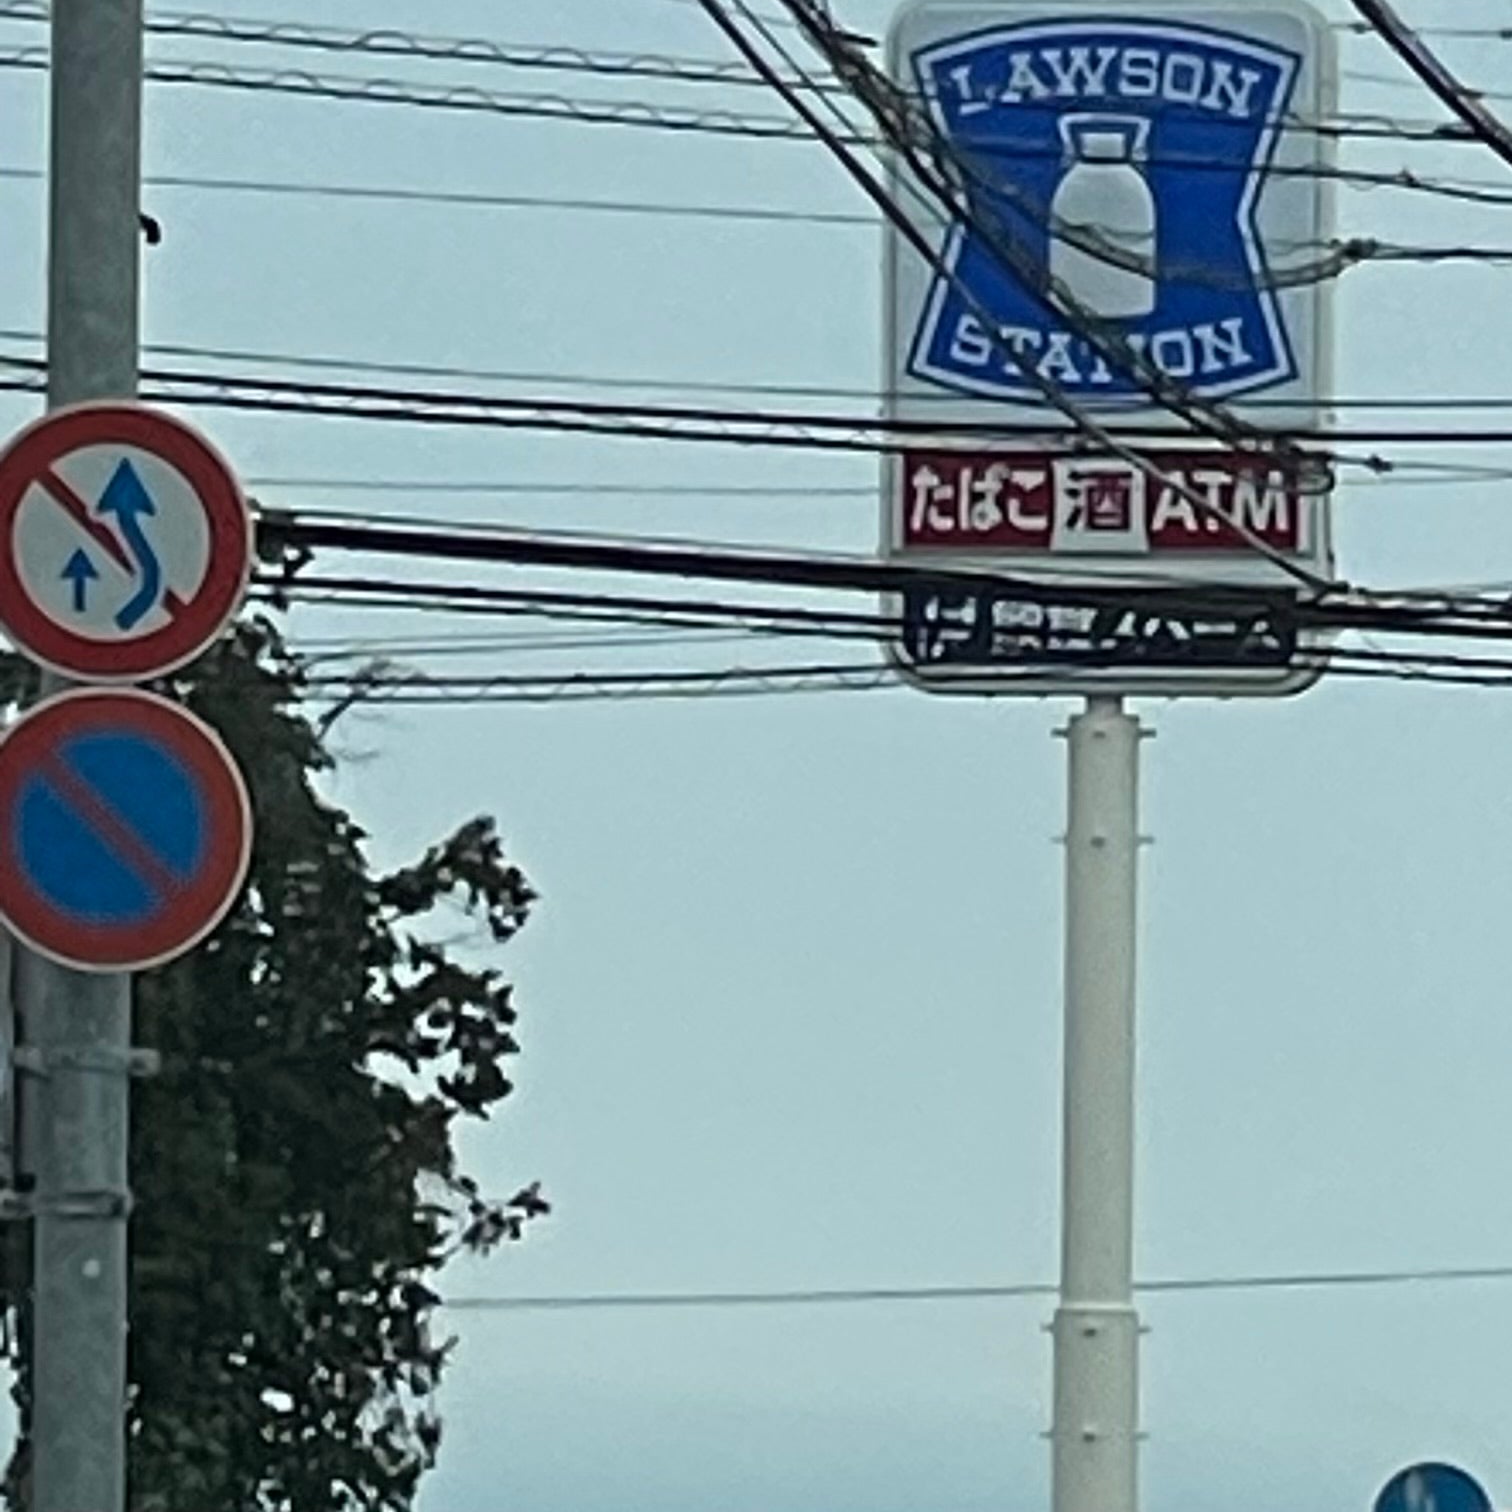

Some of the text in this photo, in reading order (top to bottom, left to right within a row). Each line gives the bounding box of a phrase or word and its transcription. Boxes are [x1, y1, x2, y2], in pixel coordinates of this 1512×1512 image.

[950, 46, 1261, 118] LAWSON
[911, 464, 1290, 533] たばこ 酒 ATM
